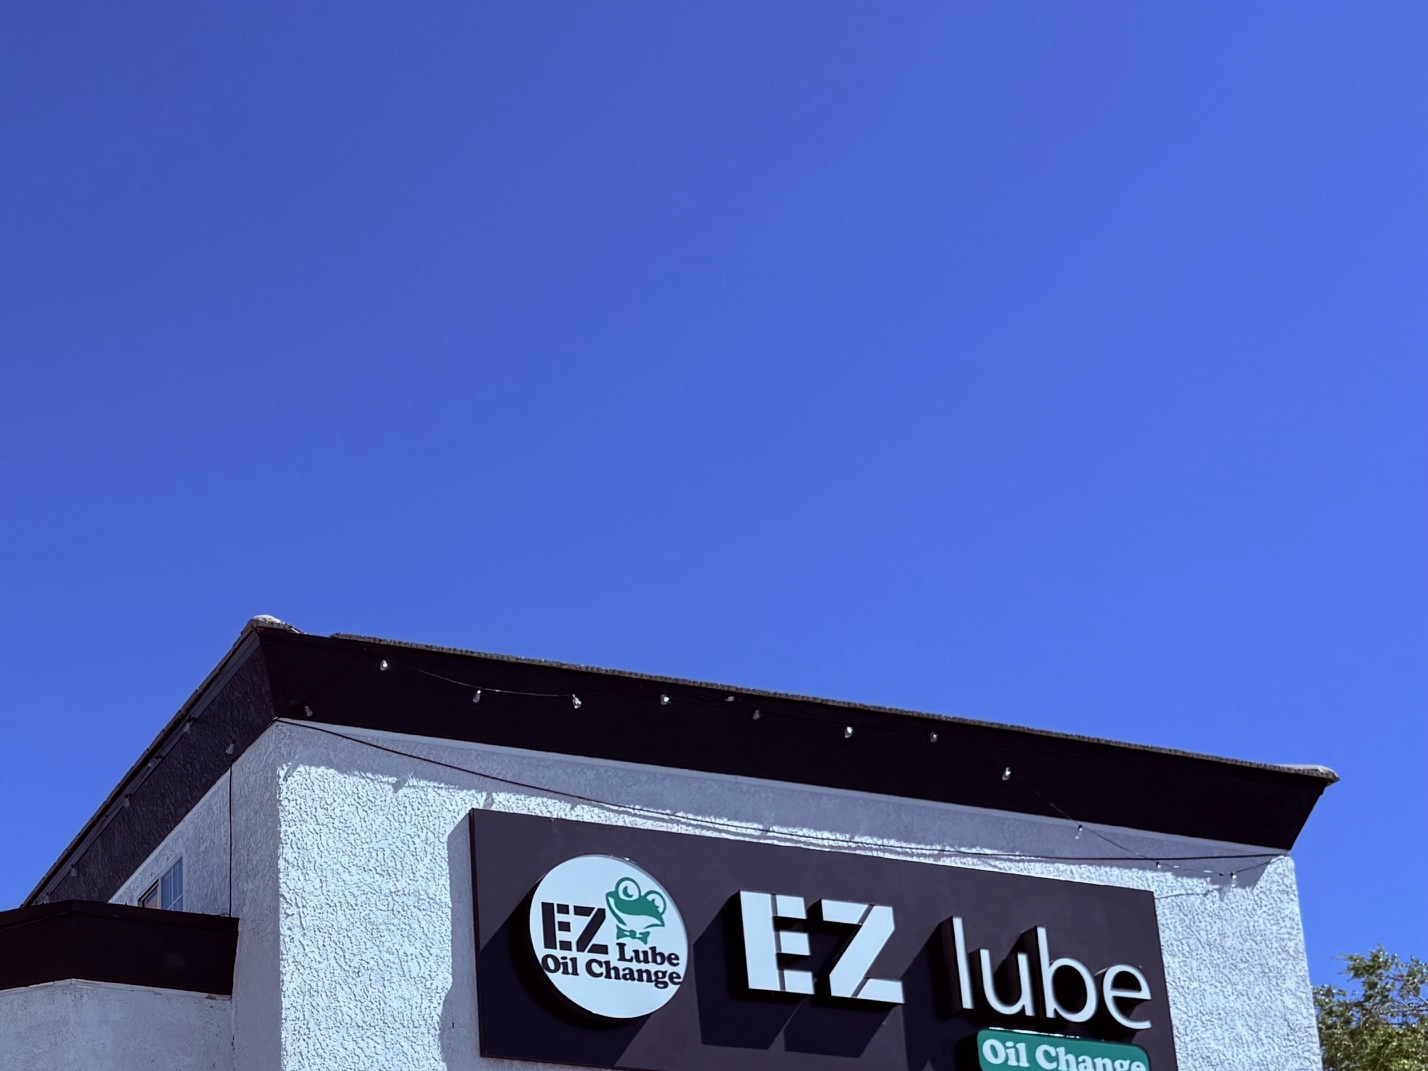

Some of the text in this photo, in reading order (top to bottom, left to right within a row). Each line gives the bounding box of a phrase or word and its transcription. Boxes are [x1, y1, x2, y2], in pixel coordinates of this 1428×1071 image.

[541, 902, 609, 955] EZ
[541, 954, 682, 989] Oil Change
[616, 942, 680, 967] Lube
[739, 890, 1152, 1030] EZ lube
[982, 1039, 1030, 1067] Oil
